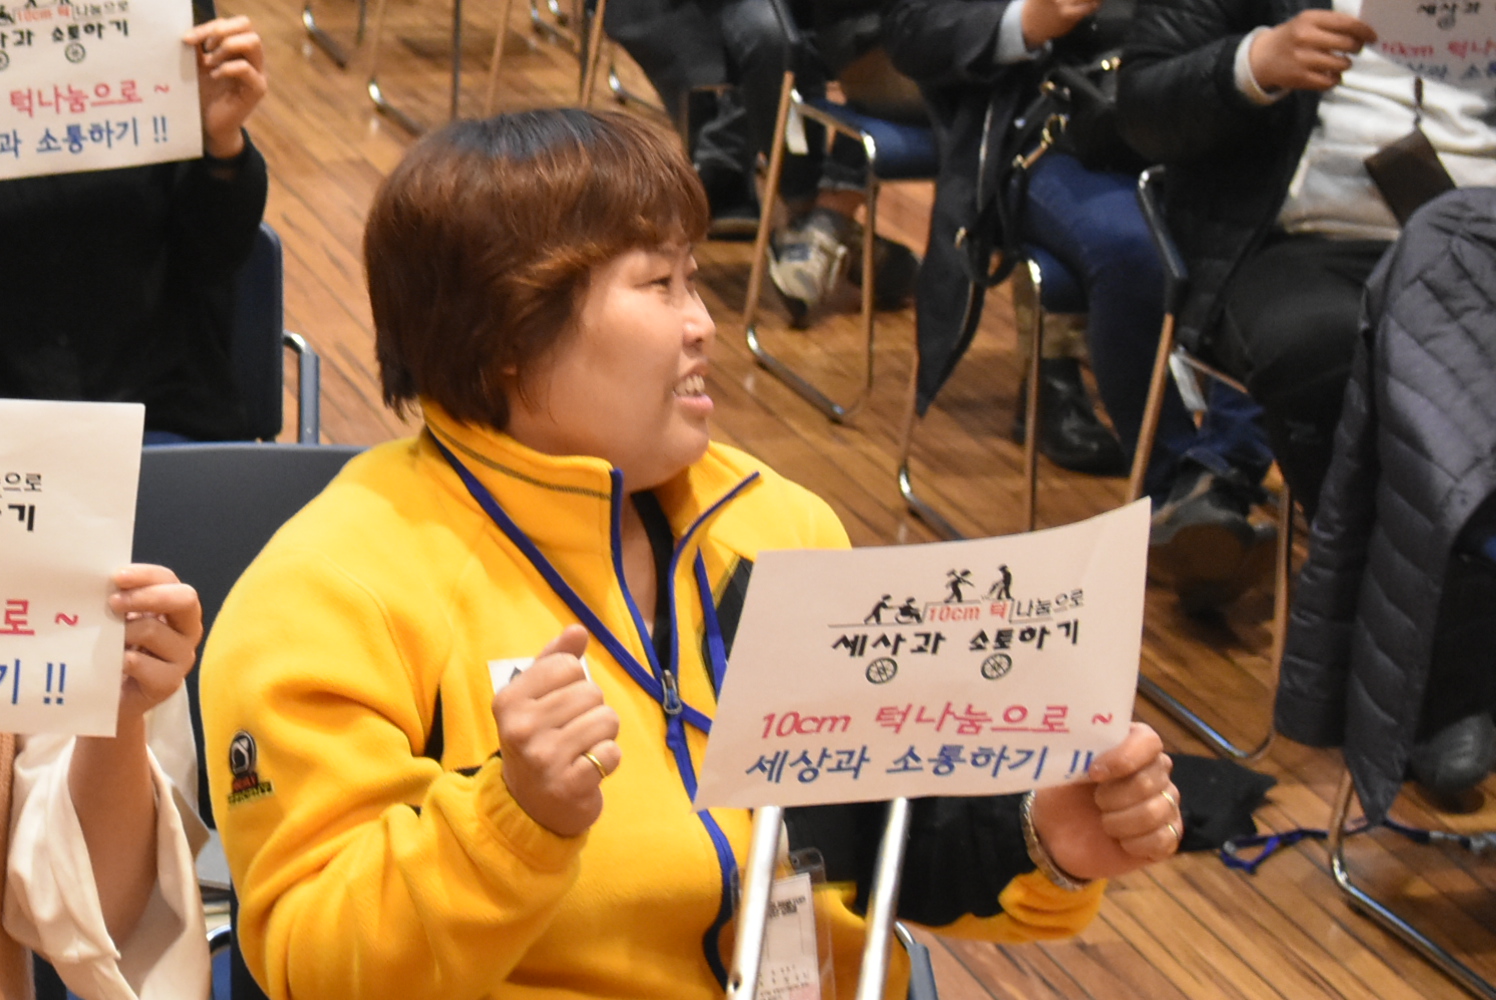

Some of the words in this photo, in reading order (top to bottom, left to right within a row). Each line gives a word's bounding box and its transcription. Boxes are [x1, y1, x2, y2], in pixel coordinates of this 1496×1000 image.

[9, 80, 144, 119] 턱나눔으로
[36, 118, 140, 156] 소통하기
[927, 604, 981, 623] 10cm
[760, 710, 852, 740] 10cm
[874, 702, 1071, 736] 턱나눔으로
[745, 744, 870, 784] 세상과
[885, 743, 1050, 781] 소통하기
